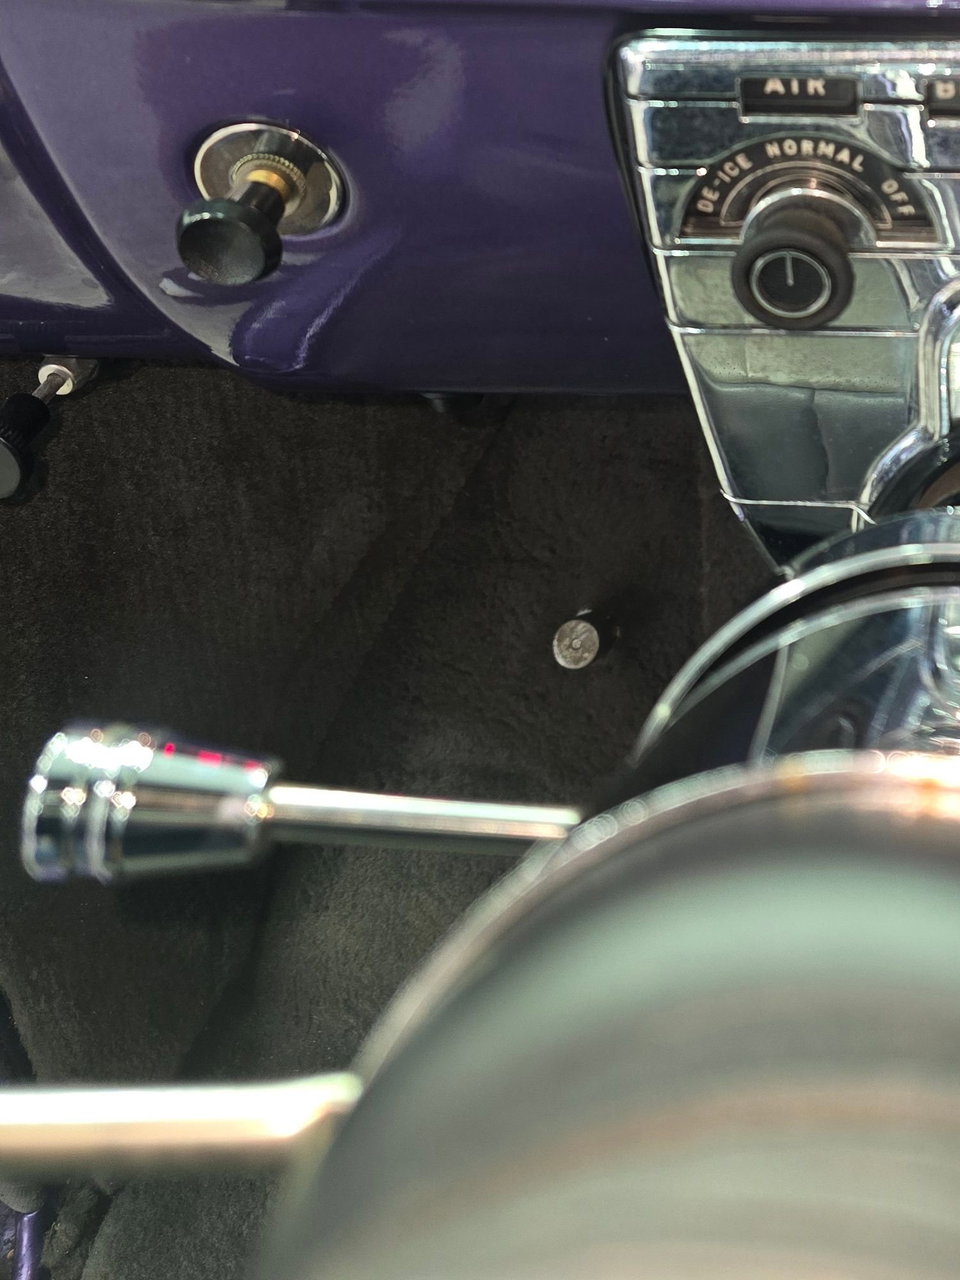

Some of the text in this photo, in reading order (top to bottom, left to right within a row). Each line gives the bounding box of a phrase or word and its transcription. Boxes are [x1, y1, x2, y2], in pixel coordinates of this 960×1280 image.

[763, 77, 827, 97] AIR
[696, 138, 916, 216] DE-ICE NORMAL OFF
